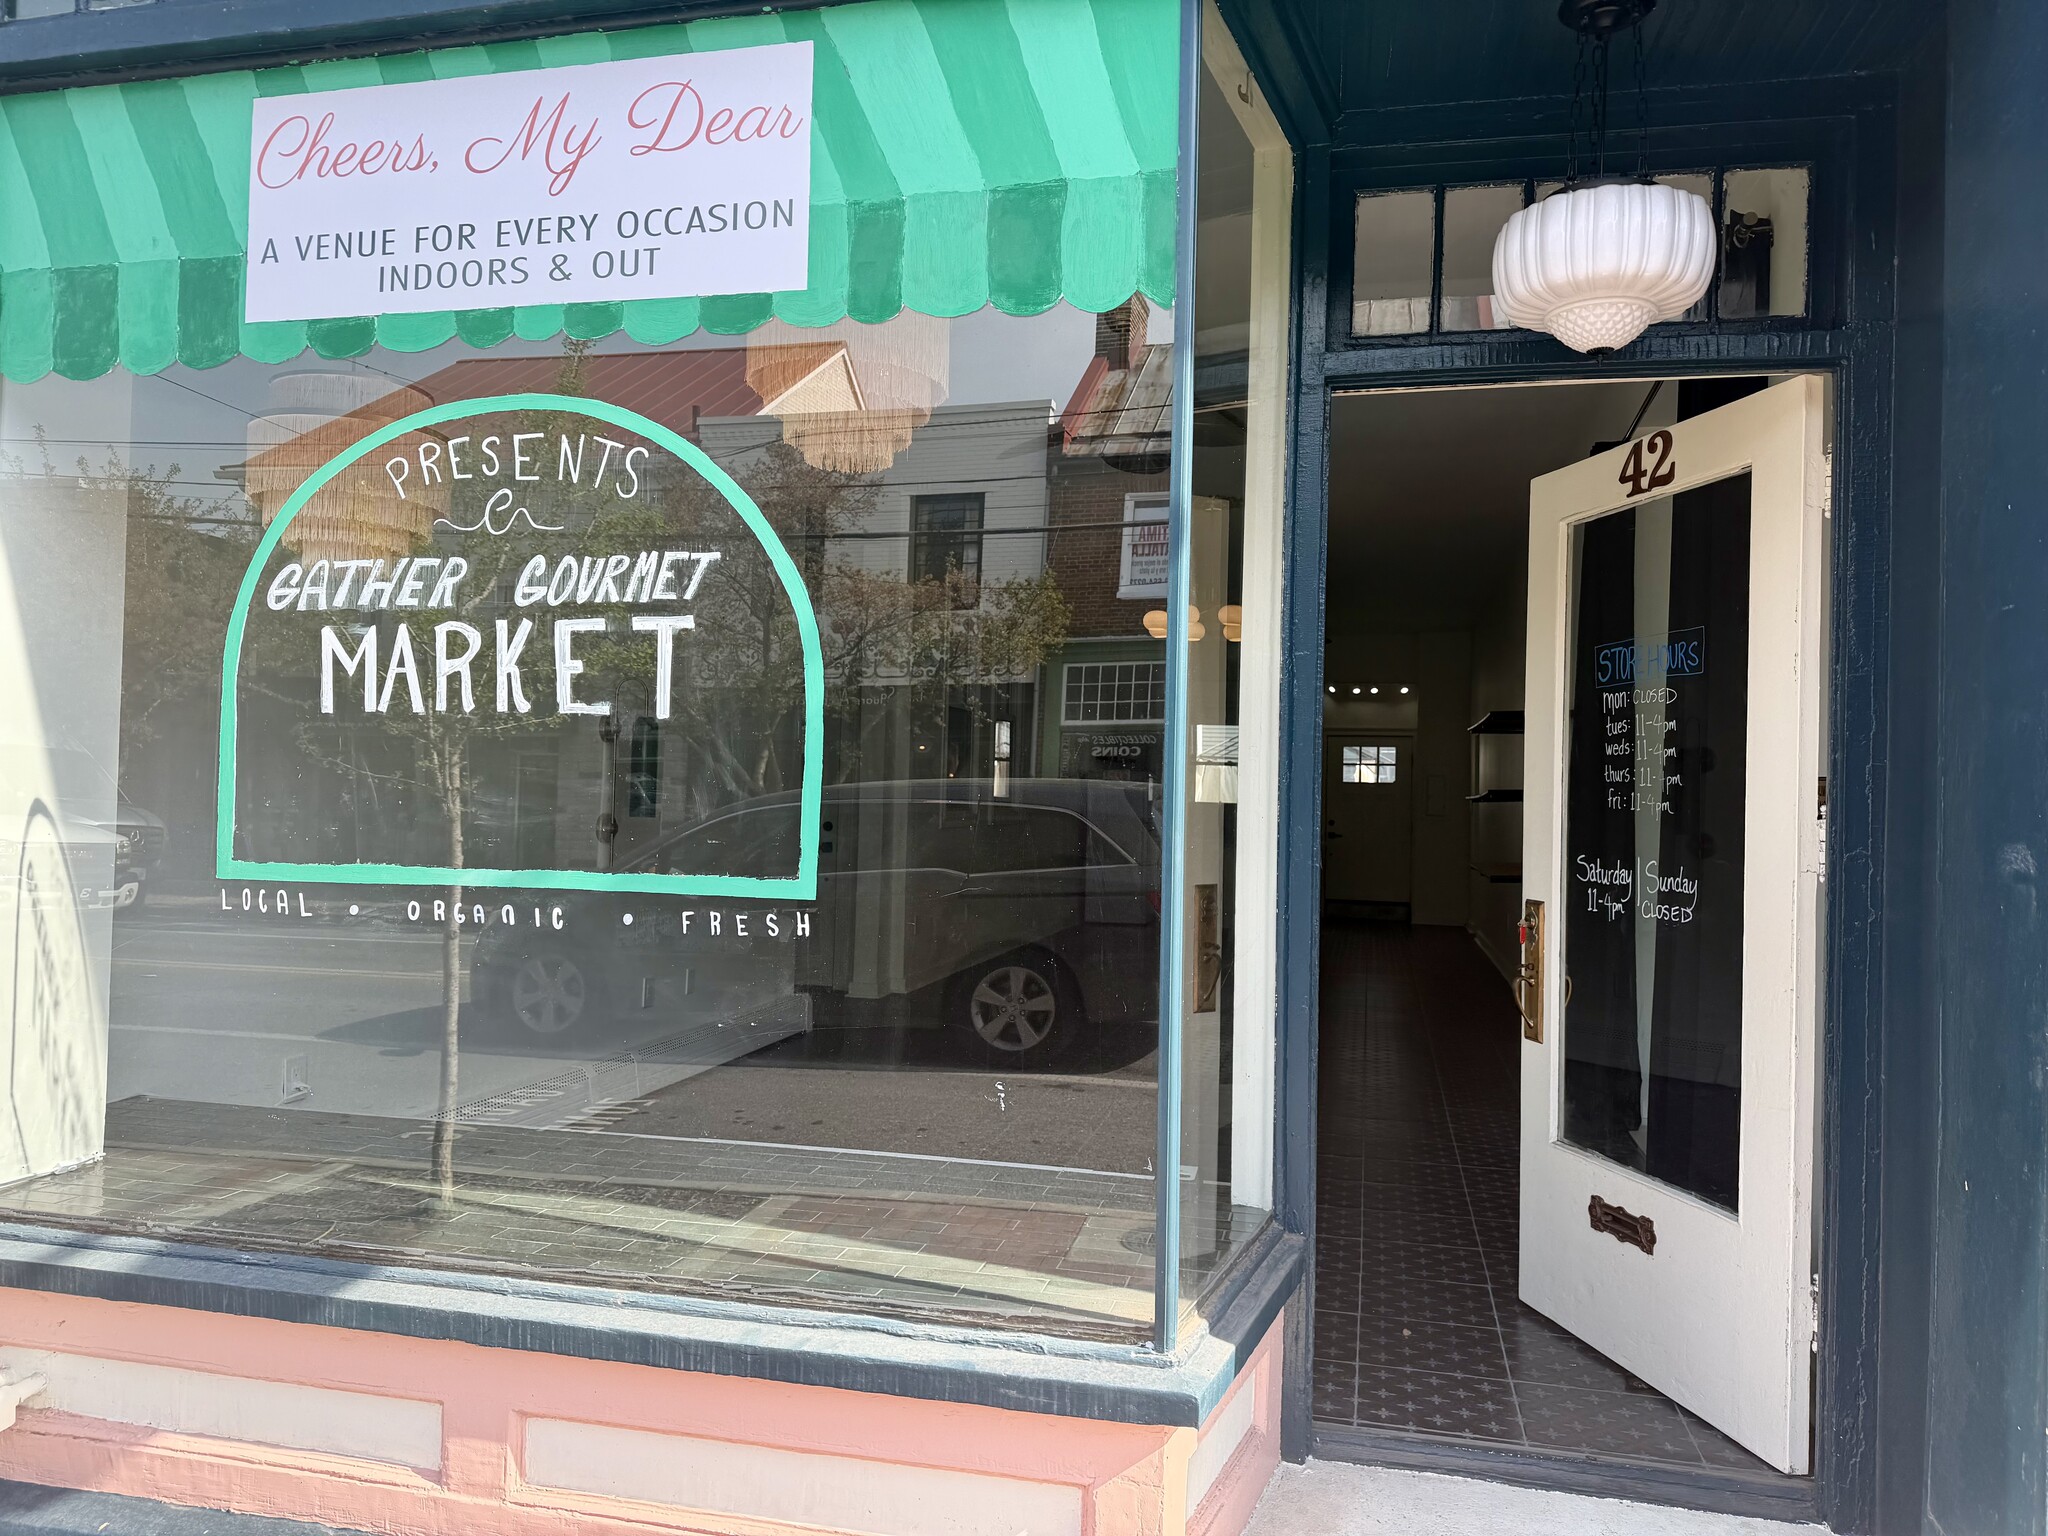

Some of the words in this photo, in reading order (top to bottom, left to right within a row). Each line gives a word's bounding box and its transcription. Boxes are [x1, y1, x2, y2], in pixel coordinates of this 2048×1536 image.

[257, 111, 439, 190] Cheers,
[464, 91, 602, 197] My
[627, 79, 803, 158] Dear
[260, 237, 280, 264] A
[294, 228, 396, 262] VENUE
[414, 222, 477, 254] FOR
[496, 213, 599, 248] EVERY
[616, 198, 796, 240] OCCASION
[378, 255, 530, 293] INDOORS
[548, 254, 573, 282] &
[592, 247, 662, 279] OUT
[385, 432, 650, 499] PRESENTS
[1618, 429, 1676, 498] 42
[266, 556, 468, 611] GATHER
[514, 551, 722, 607] GOURMET
[320, 615, 696, 720] MARKET
[1598, 645, 1645, 682] STORE
[1647, 641, 1699, 677] HOURS
[1633, 687, 1678, 705] CLOSED
[1576, 854, 1633, 902] Saturday
[1645, 860, 1698, 911] Sunday
[221, 889, 313, 918] LOCAL
[681, 910, 811, 937] FRESH
[1641, 900, 1692, 923] CLOSED
